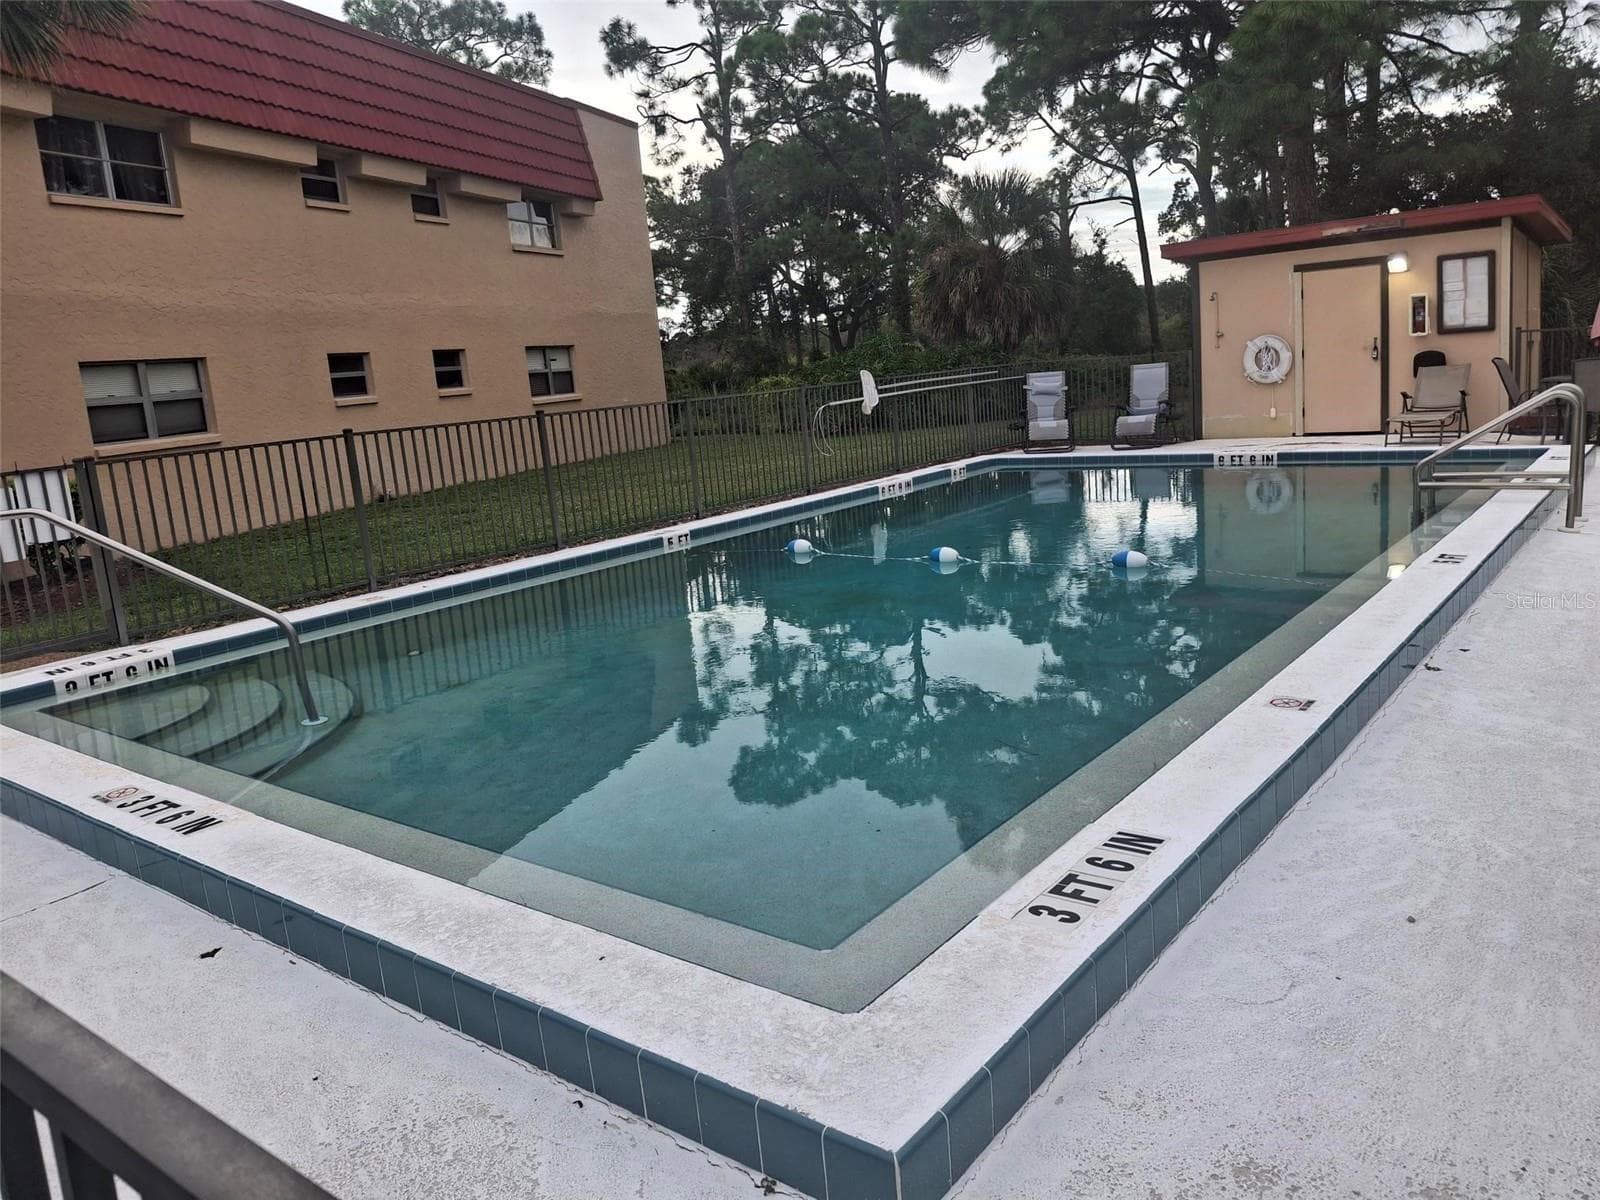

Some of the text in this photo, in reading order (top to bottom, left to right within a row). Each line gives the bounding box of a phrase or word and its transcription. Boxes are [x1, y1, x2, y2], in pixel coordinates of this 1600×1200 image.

[1262, 454, 1274, 466] IN
[678, 533, 689, 547] FT
[107, 653, 132, 661] FT
[45, 666, 74, 676] IN
[88, 670, 114, 688] FT
[147, 656, 169, 672] IN
[116, 795, 155, 809] 3
[129, 799, 181, 818] FT
[155, 809, 196, 825] 6
[170, 815, 223, 835] IN
[1028, 831, 1166, 924] 3 FT 6 IN
